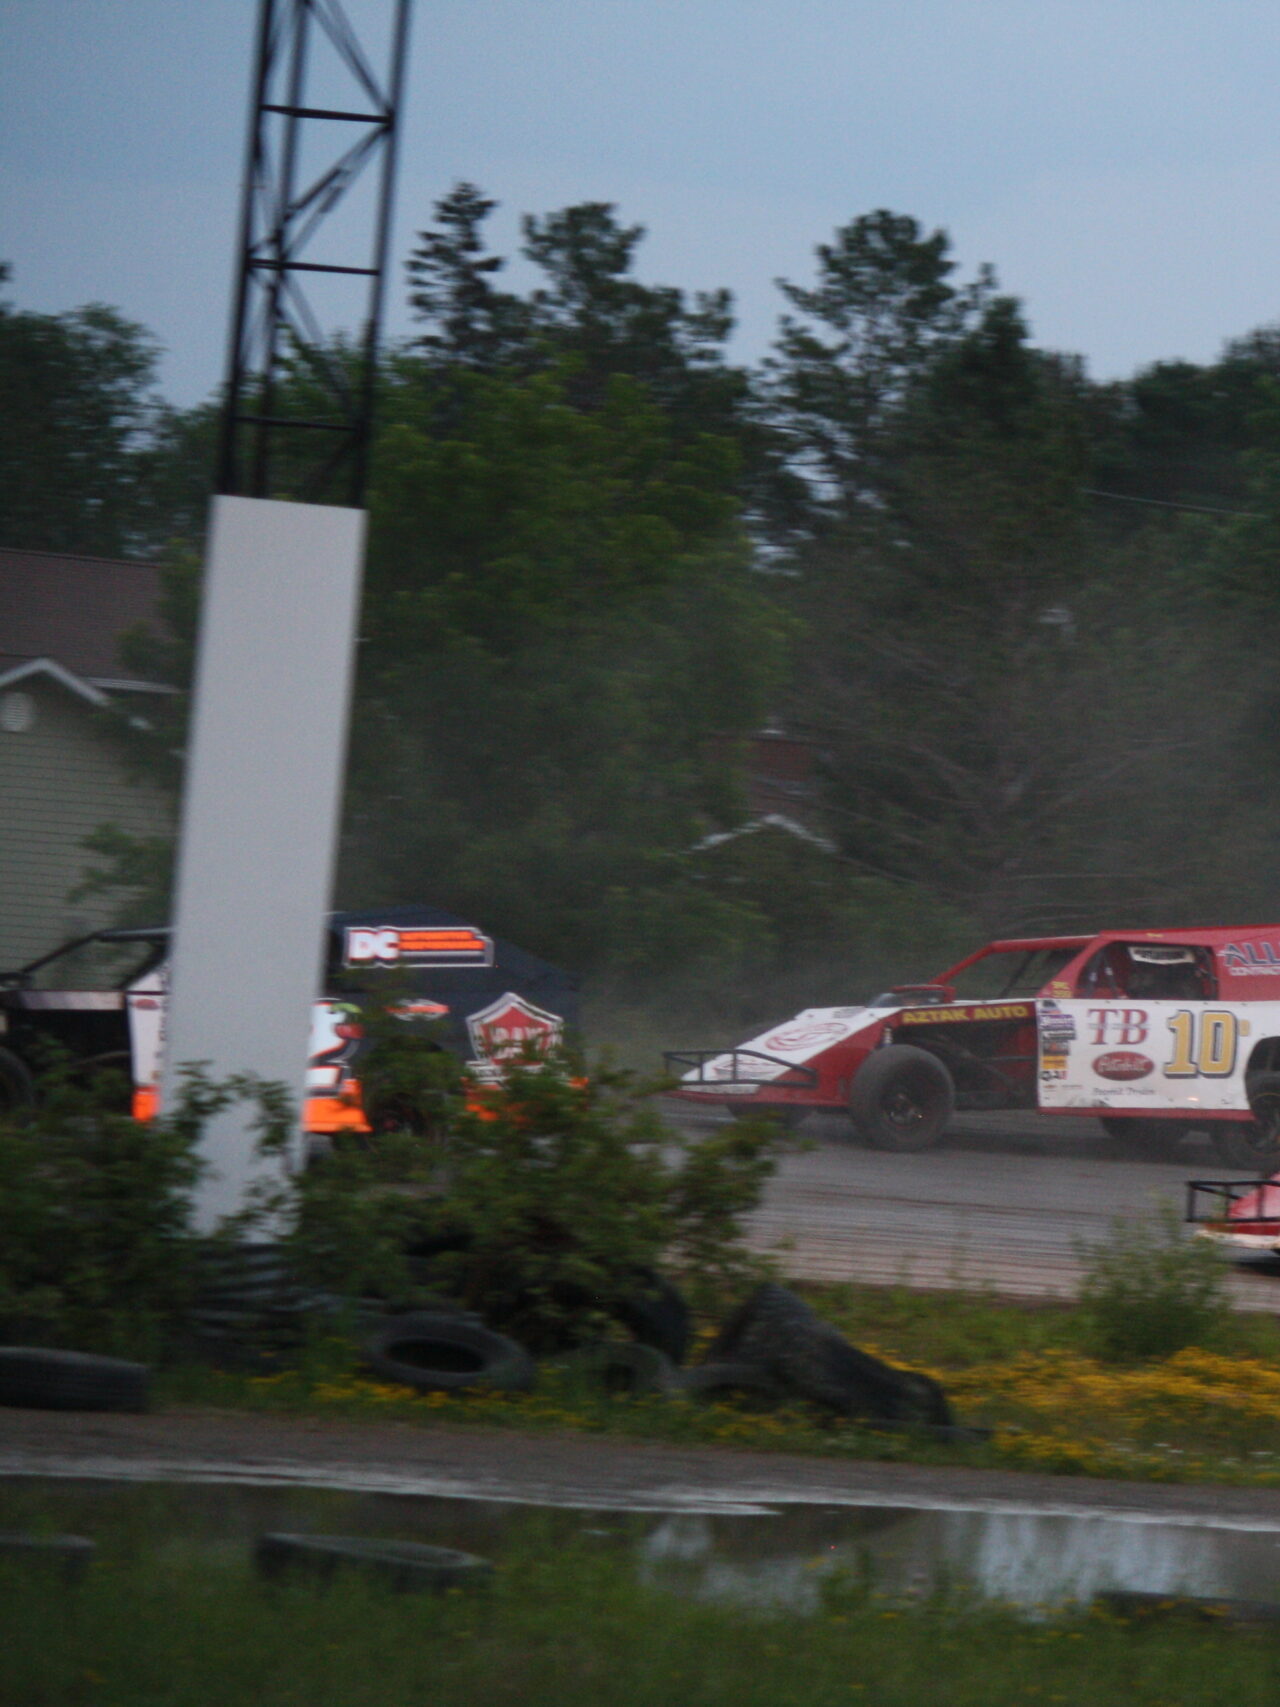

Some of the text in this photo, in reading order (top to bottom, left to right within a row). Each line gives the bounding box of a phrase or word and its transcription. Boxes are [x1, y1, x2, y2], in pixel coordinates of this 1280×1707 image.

[348, 929, 400, 961] DC
[902, 1005, 1029, 1024] AZTAK AUTO
[1087, 1008, 1150, 1046] TB
